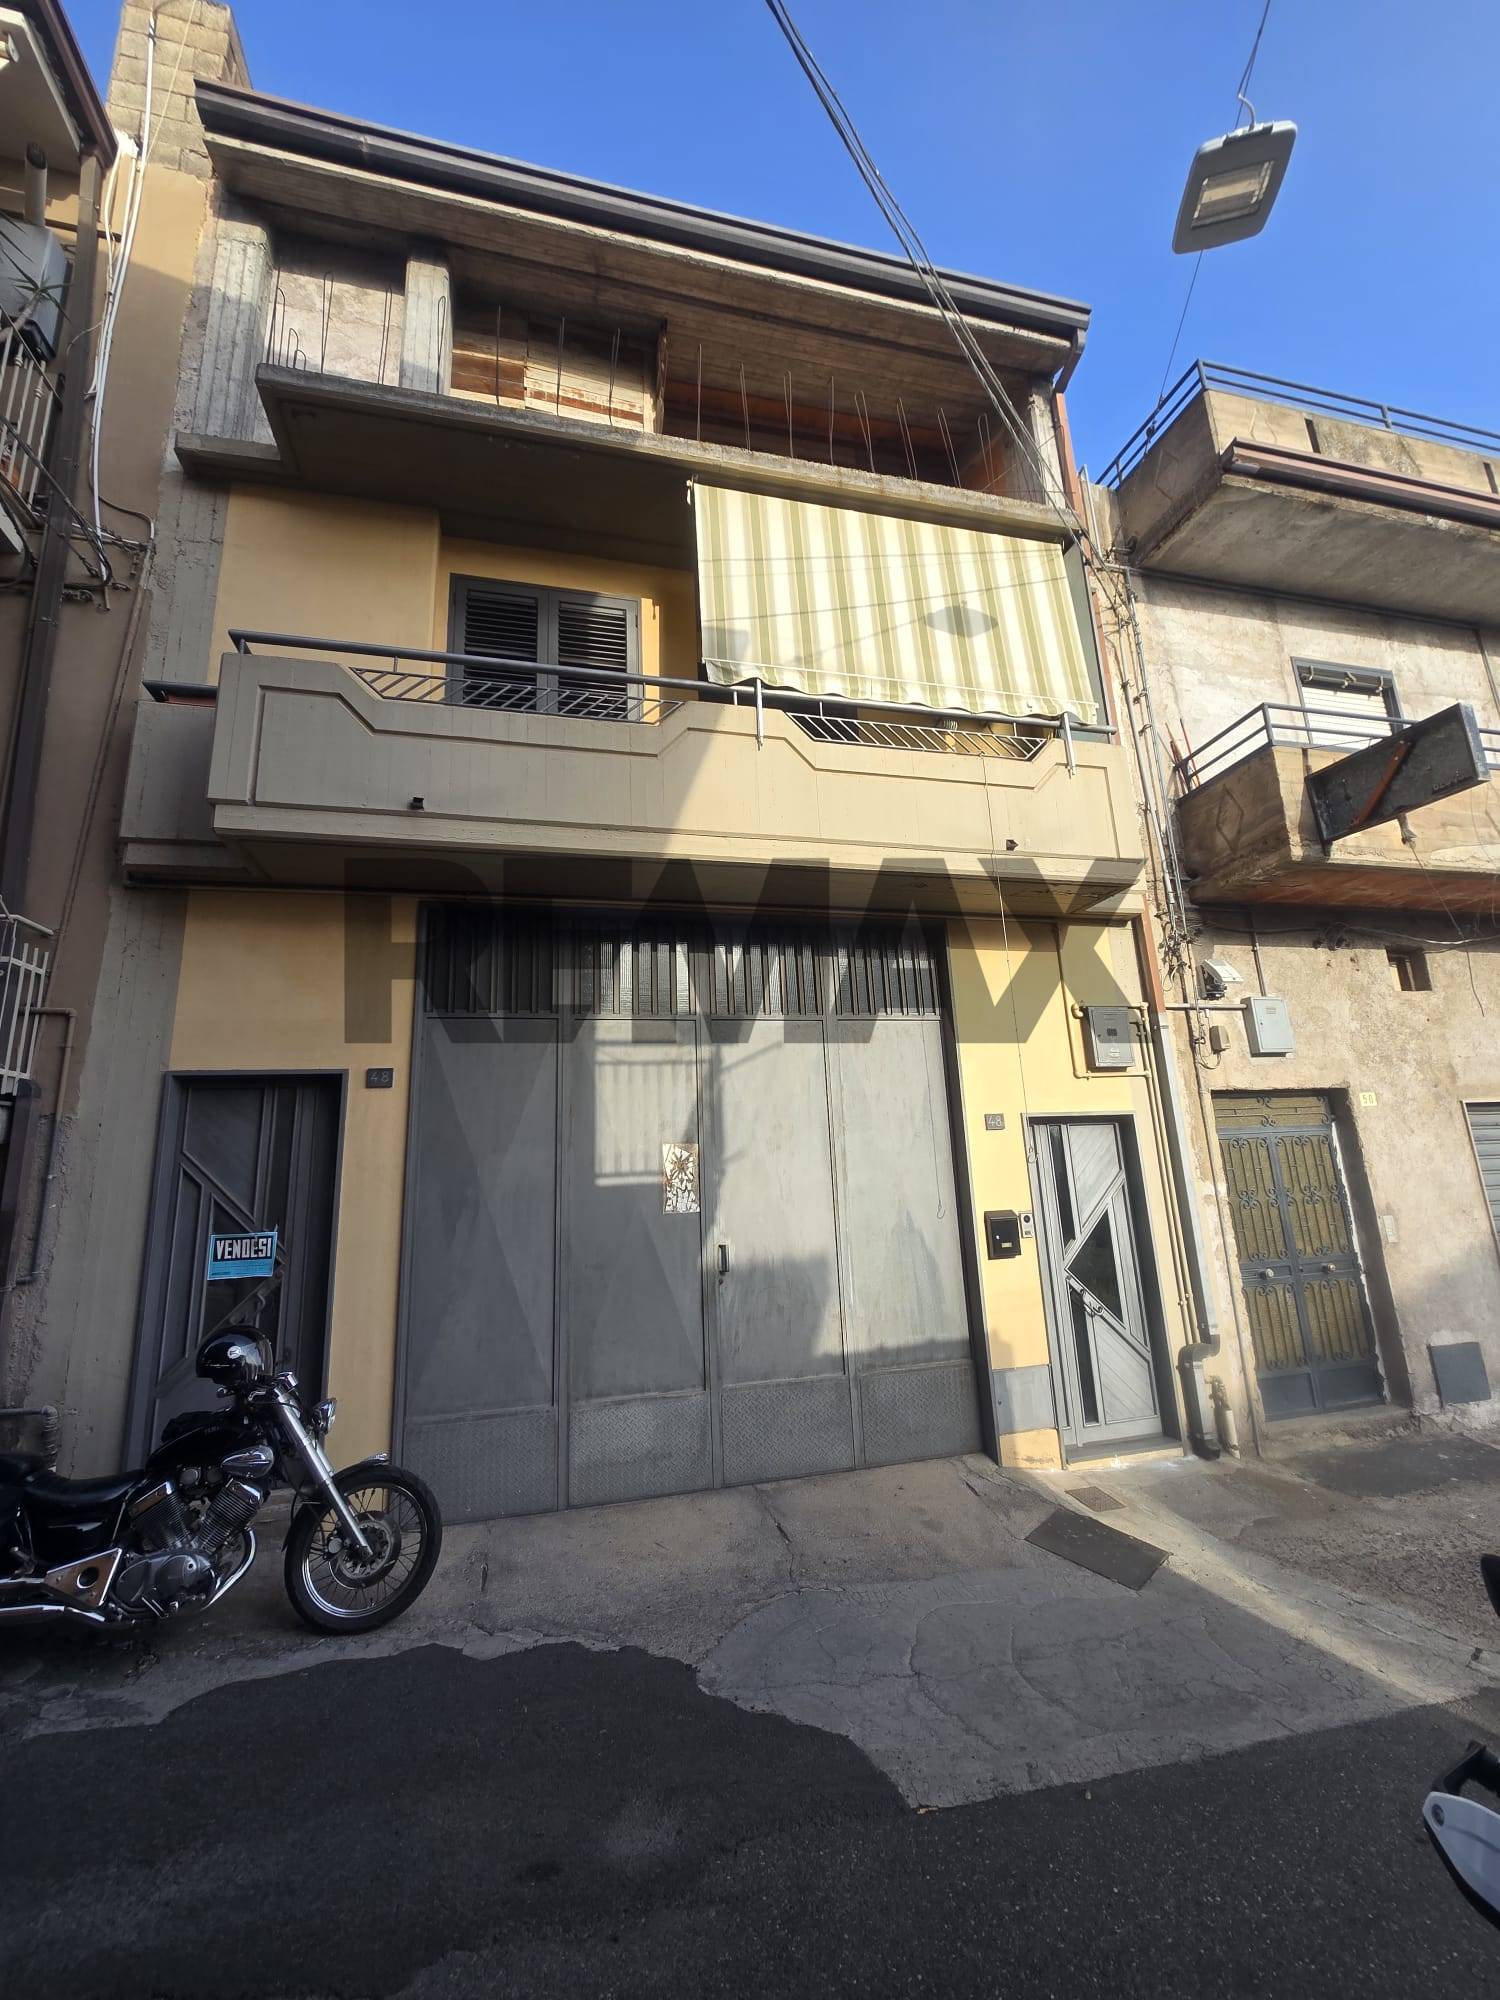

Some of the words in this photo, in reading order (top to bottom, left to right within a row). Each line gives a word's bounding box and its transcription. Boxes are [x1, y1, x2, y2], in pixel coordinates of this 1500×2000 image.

[370, 1071, 389, 1083] 48
[987, 1115, 1002, 1127] 48
[216, 1238, 272, 1260] VENDESI
